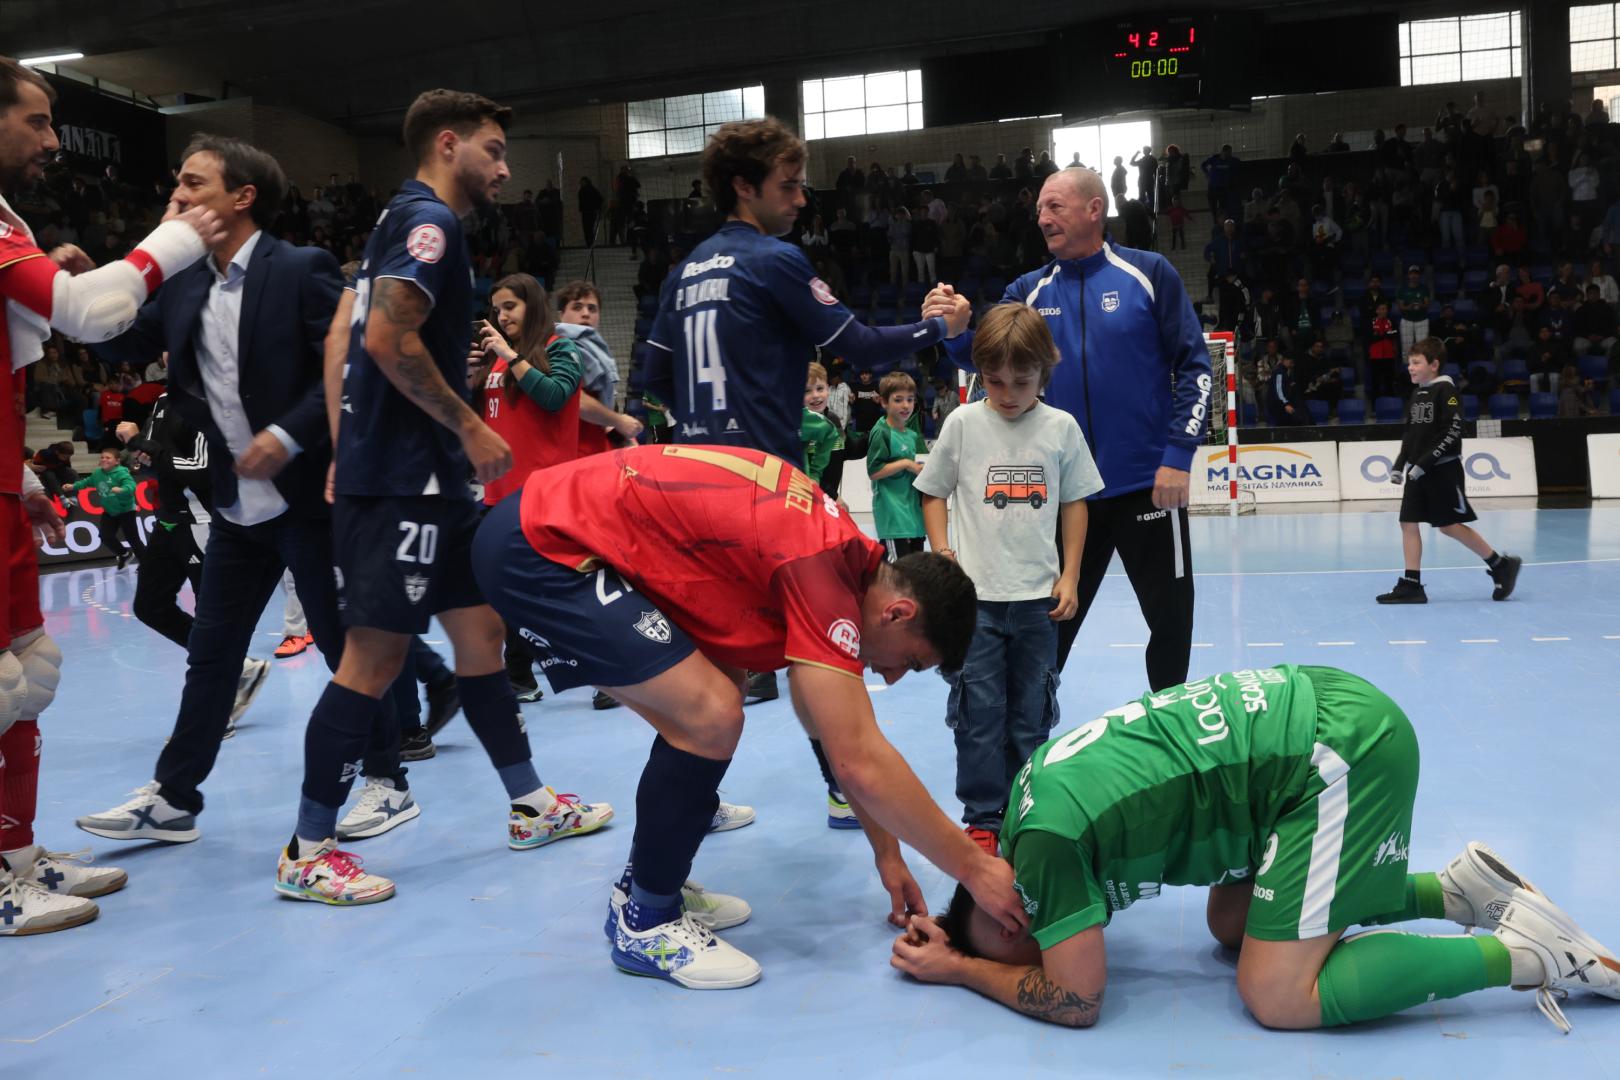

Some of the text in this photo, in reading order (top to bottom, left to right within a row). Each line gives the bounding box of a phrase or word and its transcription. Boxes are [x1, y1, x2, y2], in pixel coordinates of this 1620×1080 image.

[1148, 31, 1159, 47] 2
[1131, 57, 1178, 78] 00:00
[683, 309, 728, 413] 14
[488, 397, 500, 419] 97
[1185, 373, 1212, 437] GIOS
[1207, 463, 1323, 482] MAGNA
[395, 520, 439, 564] 20
